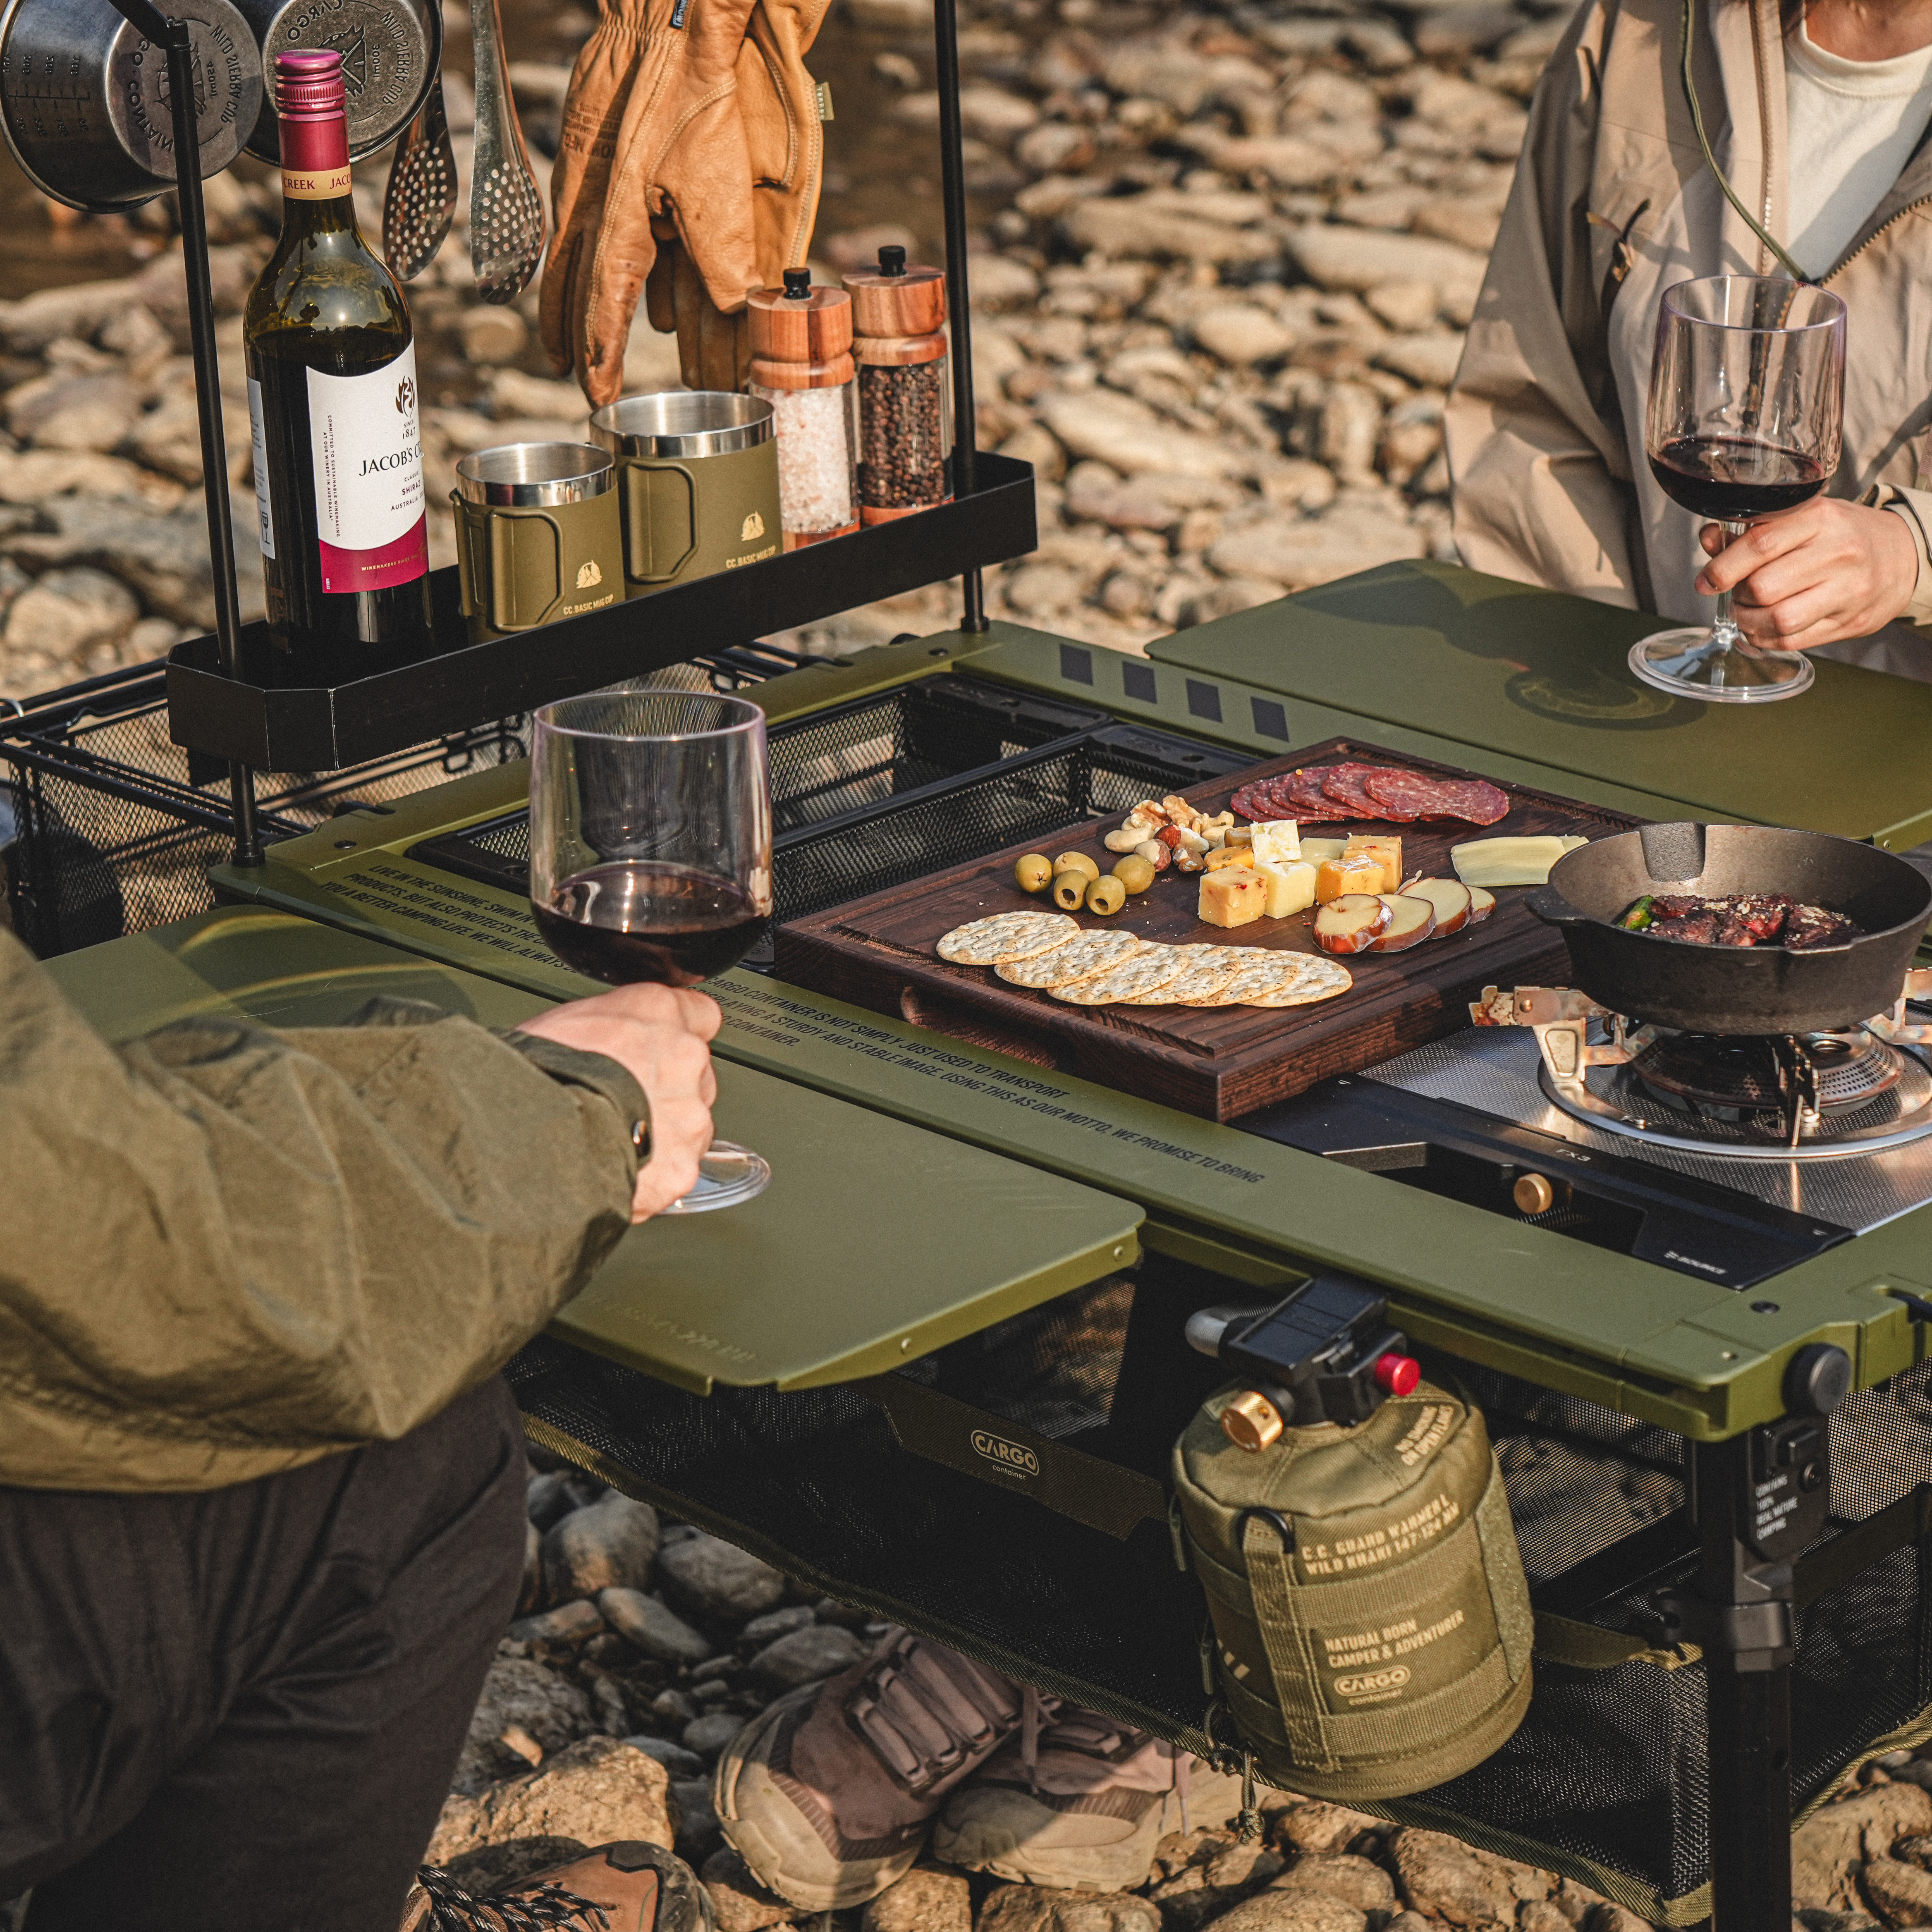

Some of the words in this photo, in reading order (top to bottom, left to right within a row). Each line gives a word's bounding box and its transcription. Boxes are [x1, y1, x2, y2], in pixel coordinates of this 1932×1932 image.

[283, 177, 315, 190] CREEK
[404, 418, 414, 428] SINCE
[402, 426, 416, 440] 1847
[359, 448, 413, 476] JACOB'S
[402, 480, 421, 495] SHIRAZ
[391, 496, 418, 511] AUSTRALIA
[361, 561, 397, 571] WINEMAKERS
[319, 881, 350, 894] YOU
[351, 892, 399, 911] BETTER
[390, 906, 449, 927] CAMPING
[468, 931, 495, 942] WE
[487, 938, 520, 952] WILL
[514, 948, 564, 968] ALWAYS
[368, 865, 401, 877] LIVE
[392, 873, 414, 881] IN
[406, 877, 435, 889] THE
[483, 904, 524, 919] SWIM
[516, 914, 535, 923] IN
[705, 977, 750, 993] CARGO
[743, 990, 817, 1016] CONTAINER
[810, 1012, 831, 1021] IS
[823, 1017, 860, 1029] NOT
[851, 1026, 906, 1045] SIMPLY
[898, 1043, 941, 1056] JUST
[933, 1052, 973, 1068] USED
[968, 1063, 992, 1074] TO
[986, 1069, 1070, 1099] TRANSPORT
[402, 893, 434, 904] BUT
[424, 901, 461, 914] ALSO
[454, 911, 517, 934] PROTECTS
[511, 929, 540, 941] THE
[771, 1016, 827, 1036] STURDY
[818, 1033, 854, 1045] AND
[848, 1042, 903, 1062] STABLE
[940, 1072, 986, 1090] USING
[981, 1086, 1017, 1100] THIS
[1009, 1096, 1037, 1107] AS
[1031, 1102, 1066, 1117] OUR
[1111, 1128, 1141, 1141] WE
[1132, 1136, 1202, 1162] PROMISE
[1197, 1156, 1220, 1168] TO
[1215, 1164, 1265, 1183] BRING
[975, 1435, 1036, 1471] CARGO
[992, 1465, 1026, 1480] container
[1305, 1557, 1344, 1575] WILD
[1324, 1631, 1380, 1653] NATURAL
[1382, 1618, 1418, 1642] BORN
[1328, 1647, 1380, 1669] CAMPER
[1381, 1644, 1393, 1659] &
[1395, 1609, 1465, 1655] ADVENTURER
[1337, 1669, 1407, 1693] CARGO
[1348, 1688, 1403, 1706] container
